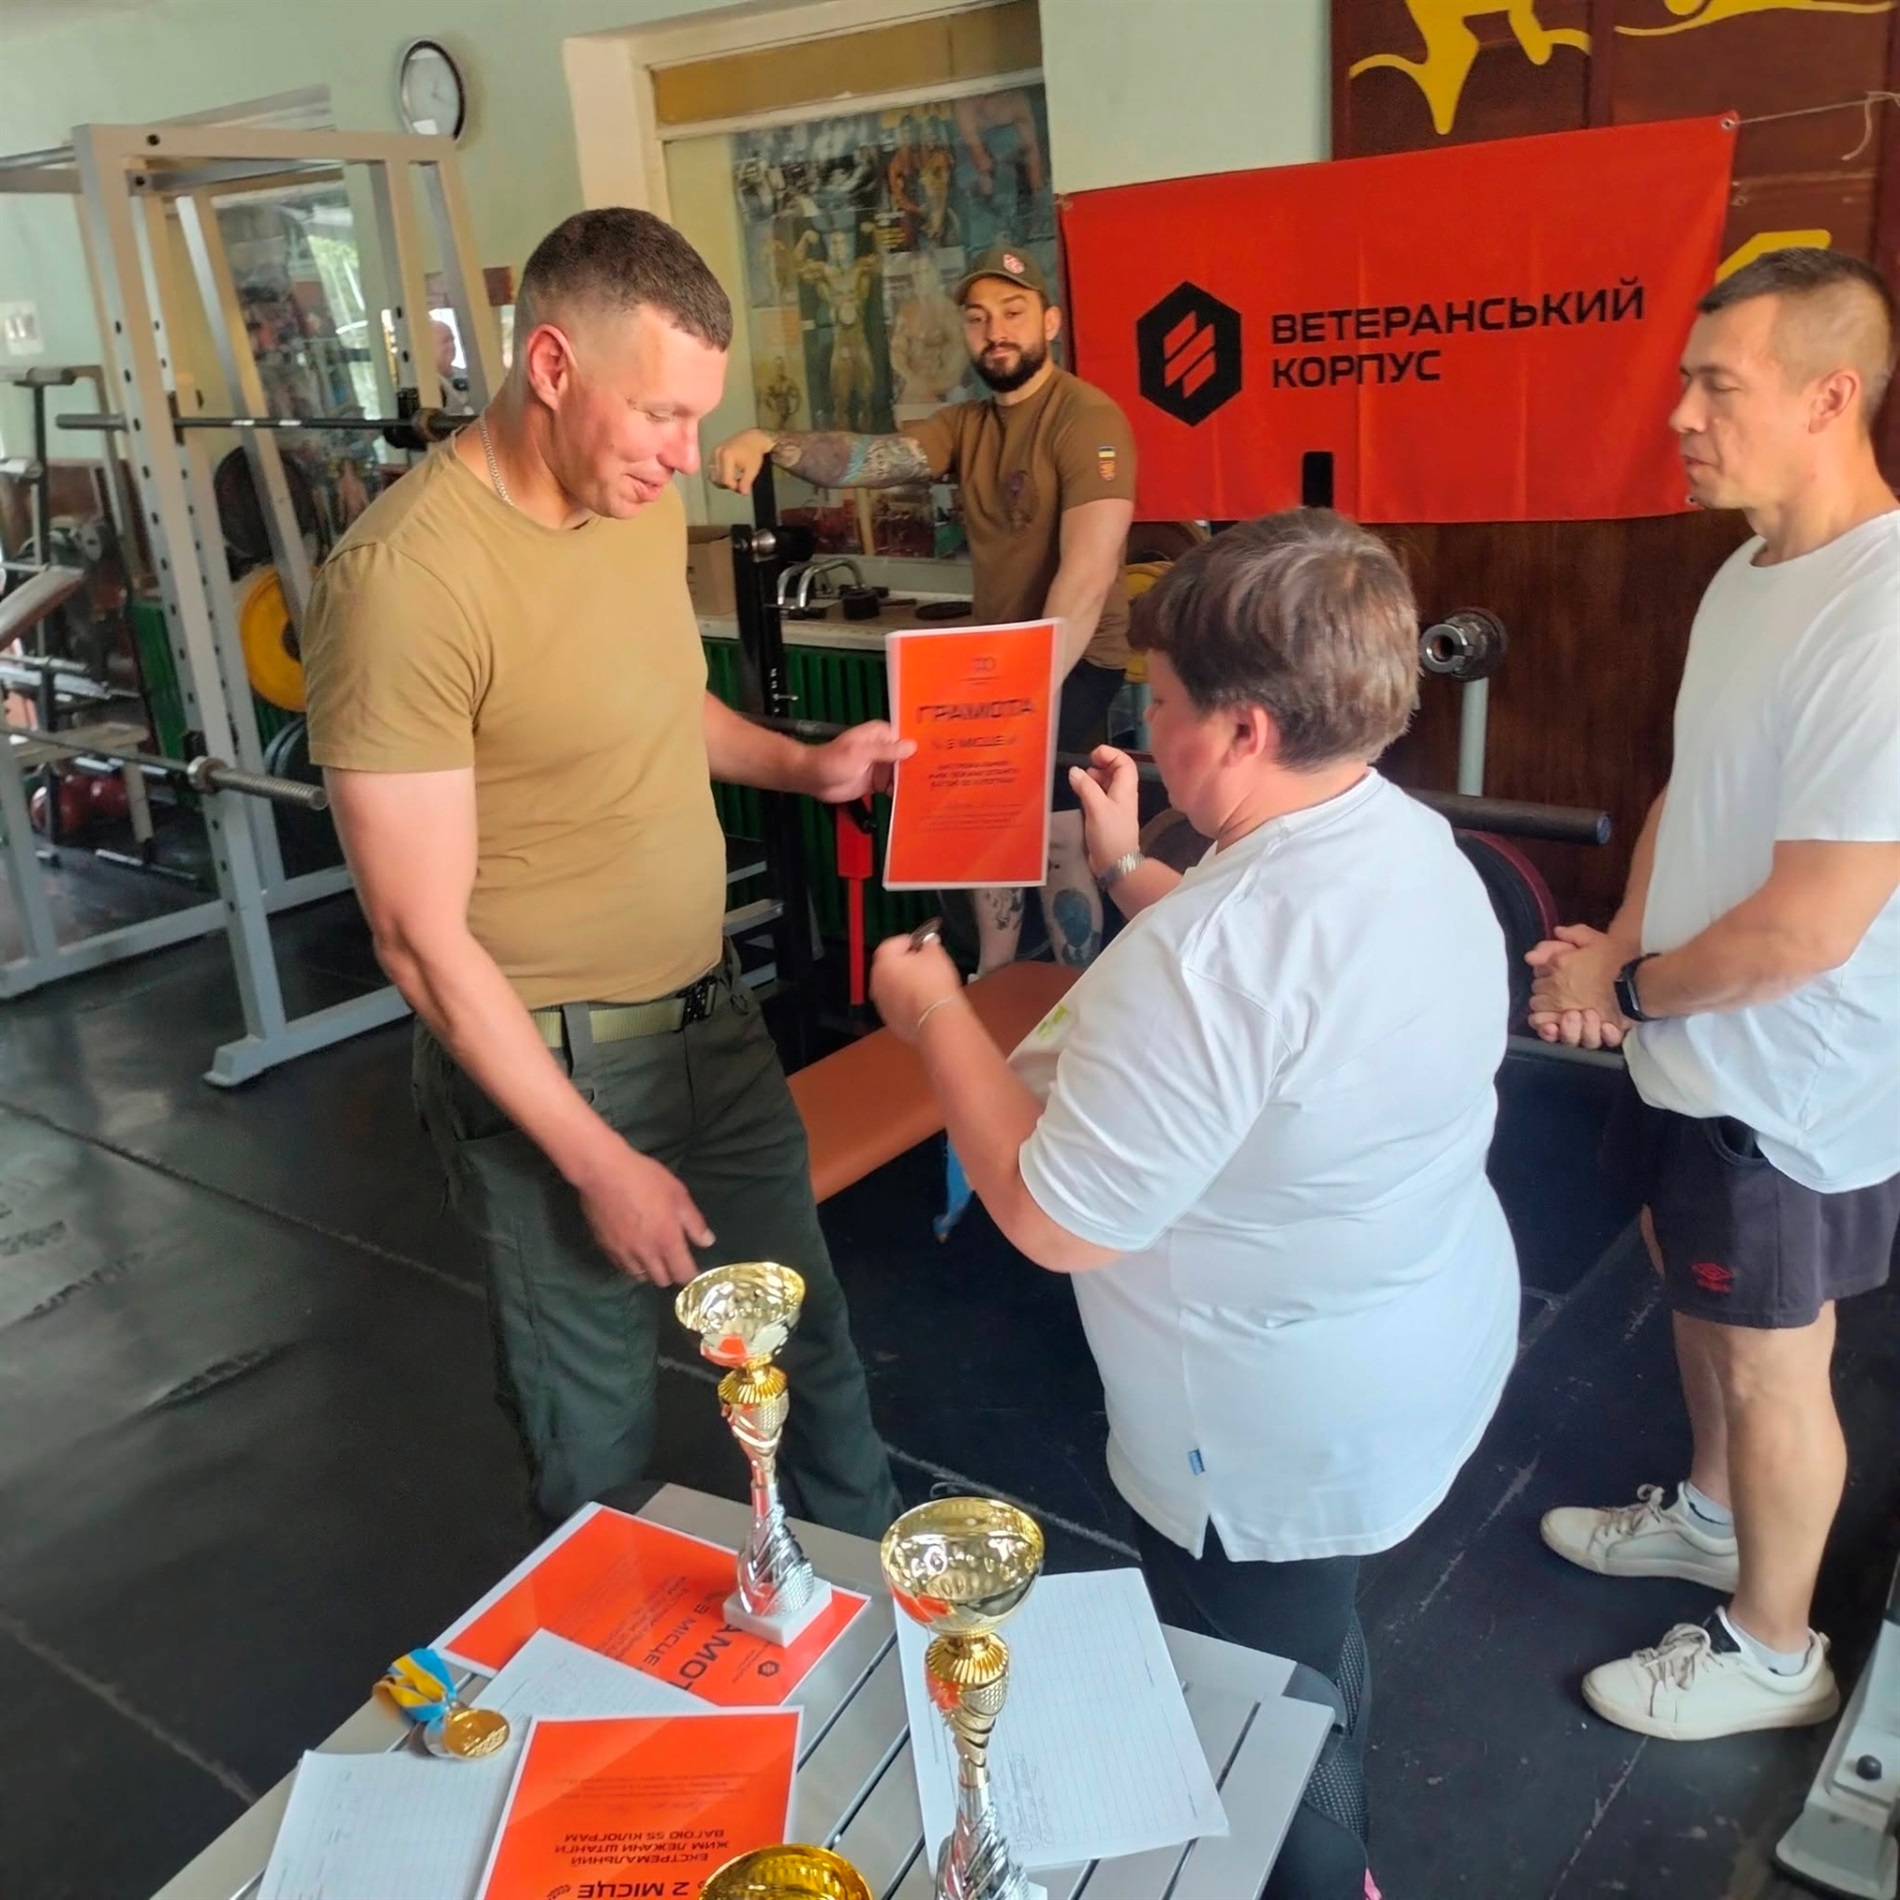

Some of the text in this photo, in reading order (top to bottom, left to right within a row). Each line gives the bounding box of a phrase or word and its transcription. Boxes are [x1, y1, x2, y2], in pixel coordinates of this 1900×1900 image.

[1271, 276, 1644, 345] ВЕТЕРАНСЬКИЙ
[1272, 350, 1441, 388] КОРПУС
[643, 1617, 696, 1667] МІСЦЕ
[667, 1624, 743, 1691] АМОТ
[564, 1831, 643, 1843] КІЛОГРАМ
[669, 1828, 725, 1840] ВАГОЮ
[554, 1840, 729, 1855] ЖИМ ЛЕЖАЧИ ШТАНГИ
[571, 1852, 709, 1867] ЕКСТРЕМАЛЬНИЙ
[577, 1880, 690, 1899] 2 МІСЦЕ
